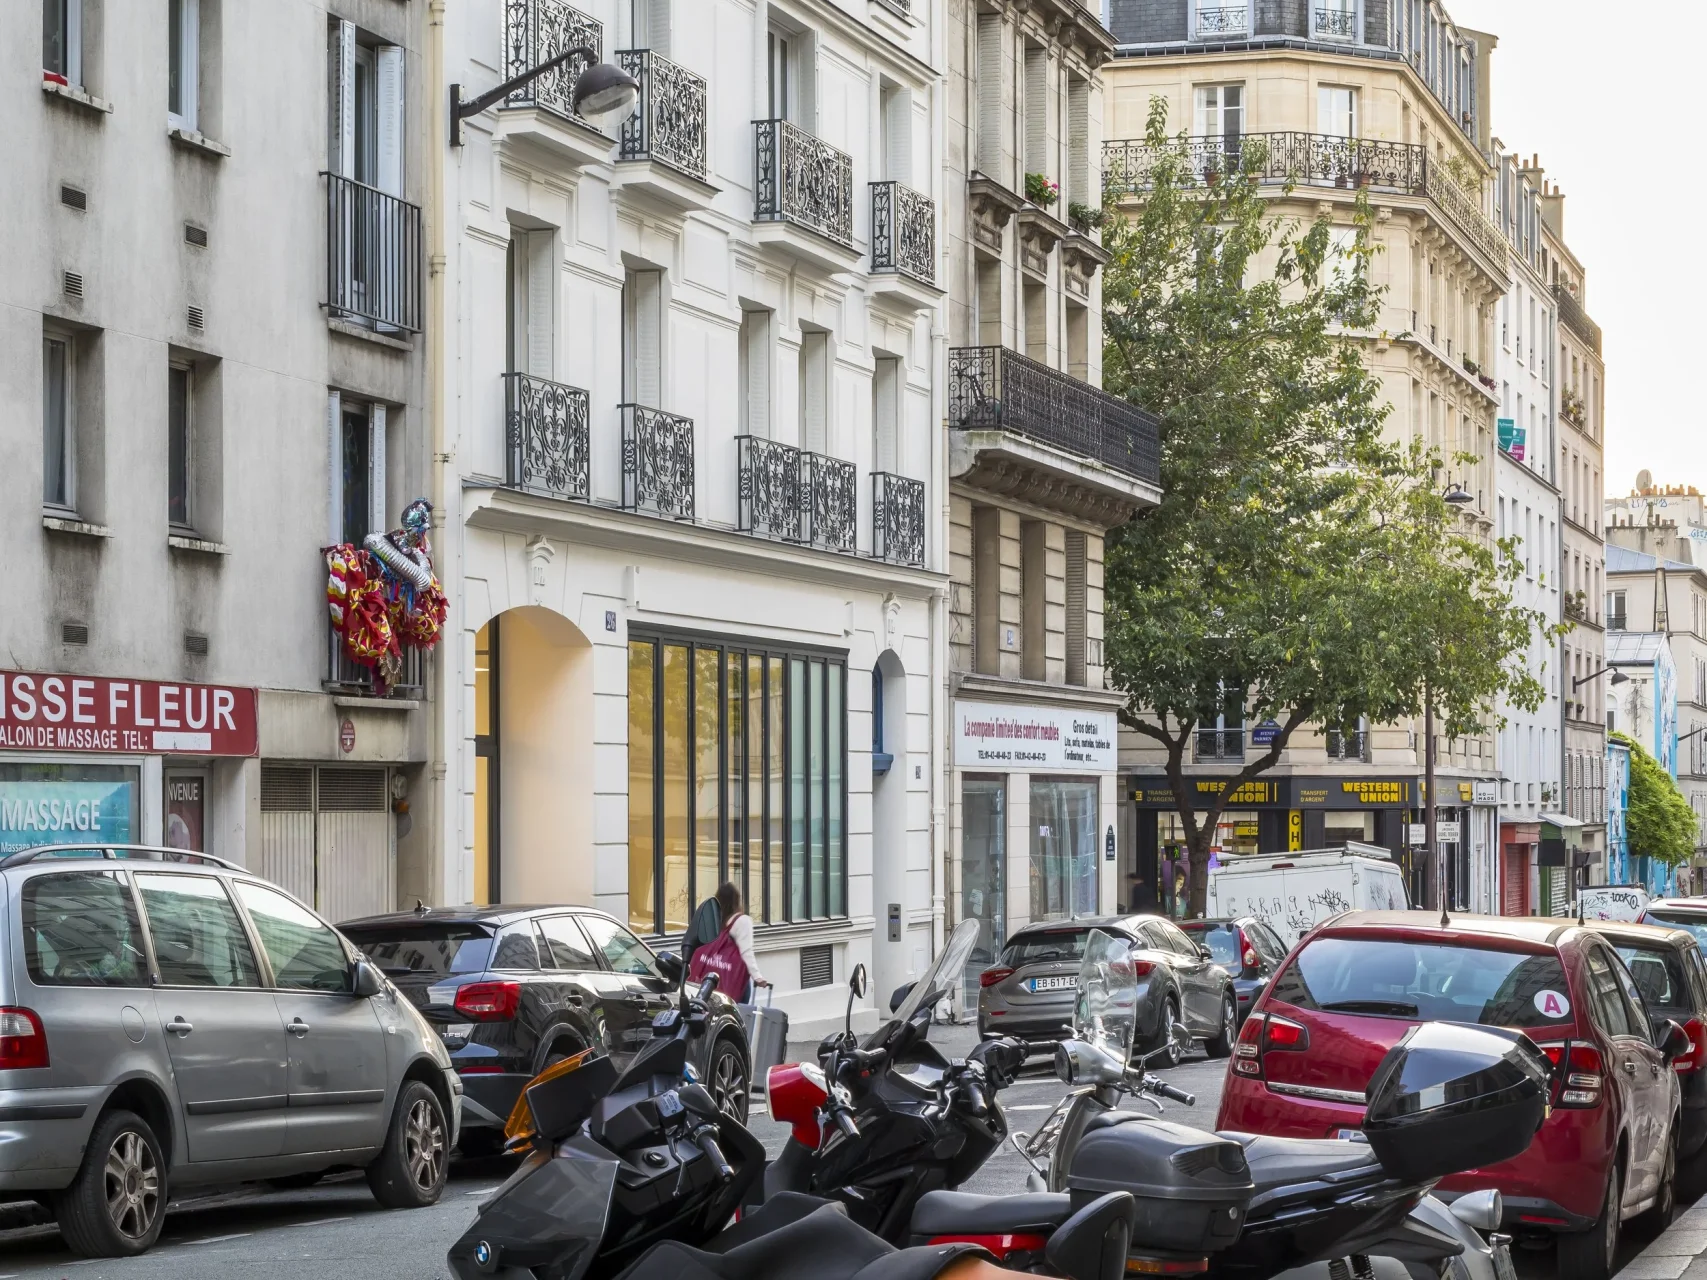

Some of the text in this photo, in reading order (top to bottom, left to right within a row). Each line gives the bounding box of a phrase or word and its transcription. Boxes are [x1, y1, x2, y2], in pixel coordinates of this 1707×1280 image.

[607, 613, 615, 629] 26
[109, 682, 236, 730] FLEUR
[1073, 720, 1084, 733] Gros
[38, 727, 54, 747] DE
[58, 728, 117, 749] MASSAGE
[123, 731, 148, 749] TEL:
[1196, 782, 1265, 792] WESERN
[1343, 782, 1399, 792] WESTERN
[1360, 792, 1399, 803] UNION
[1, 798, 101, 832] MASSAGE
[1291, 815, 1300, 851] CH
[1544, 994, 1562, 1014] A
